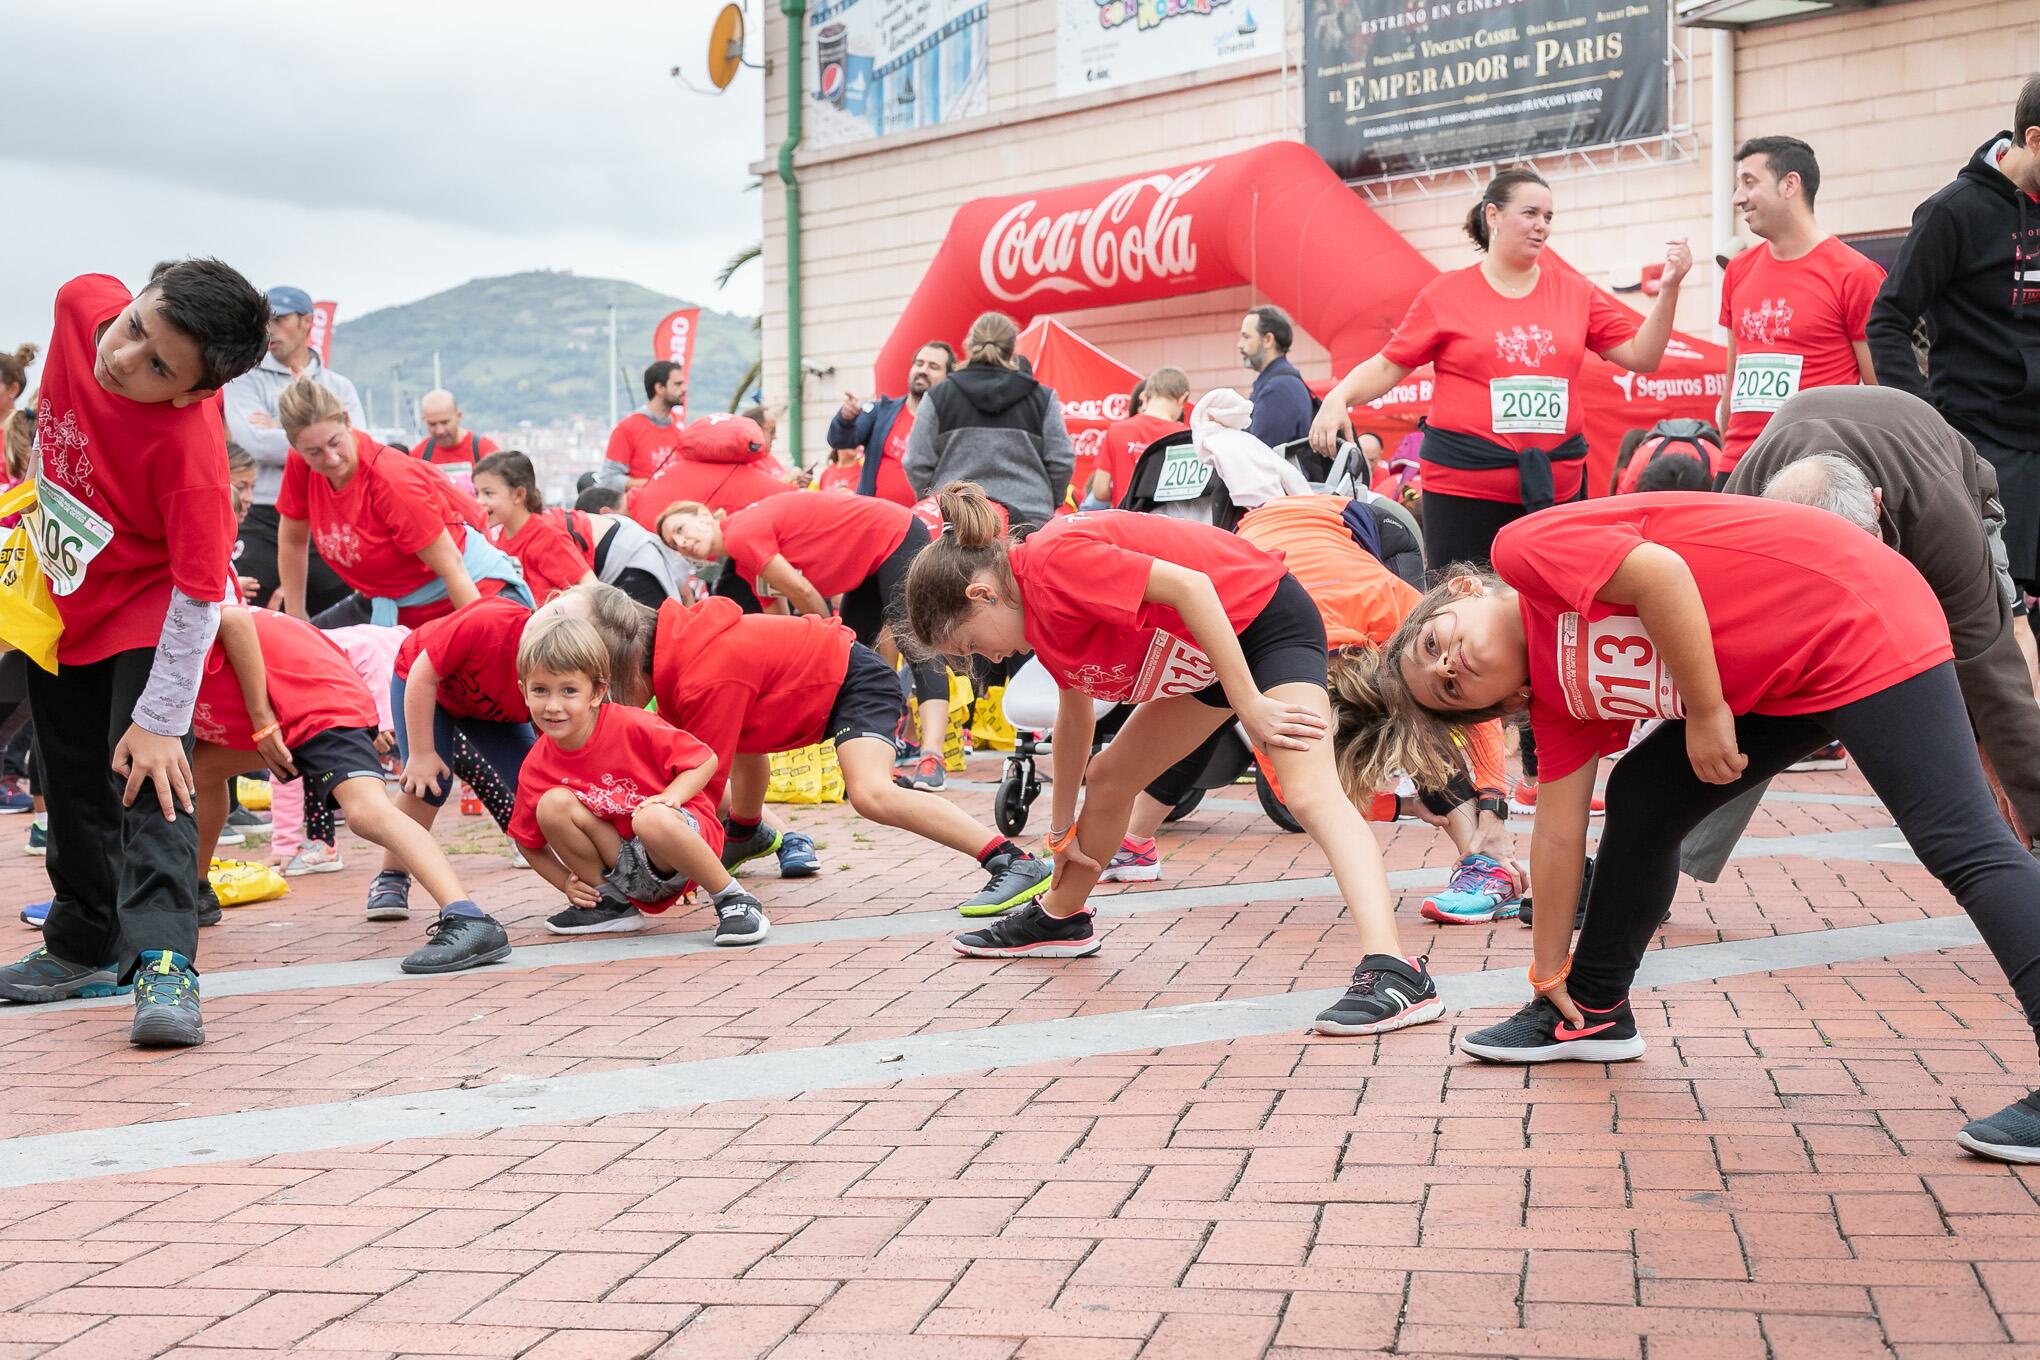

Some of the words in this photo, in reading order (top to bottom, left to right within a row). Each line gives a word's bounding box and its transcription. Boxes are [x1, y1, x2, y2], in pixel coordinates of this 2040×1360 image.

[1361, 9, 1427, 35] ESTRENO
[1431, 4, 1451, 20] EN
[1344, 54, 1509, 112] EMPERADOR
[1535, 32, 1624, 78] PARIS
[980, 163, 1215, 302] Coca-Cola
[1636, 375, 1702, 402] Seguros
[1736, 370, 1791, 398] 2026
[1502, 392, 1561, 418] 2026
[1164, 459, 1208, 486] 2026
